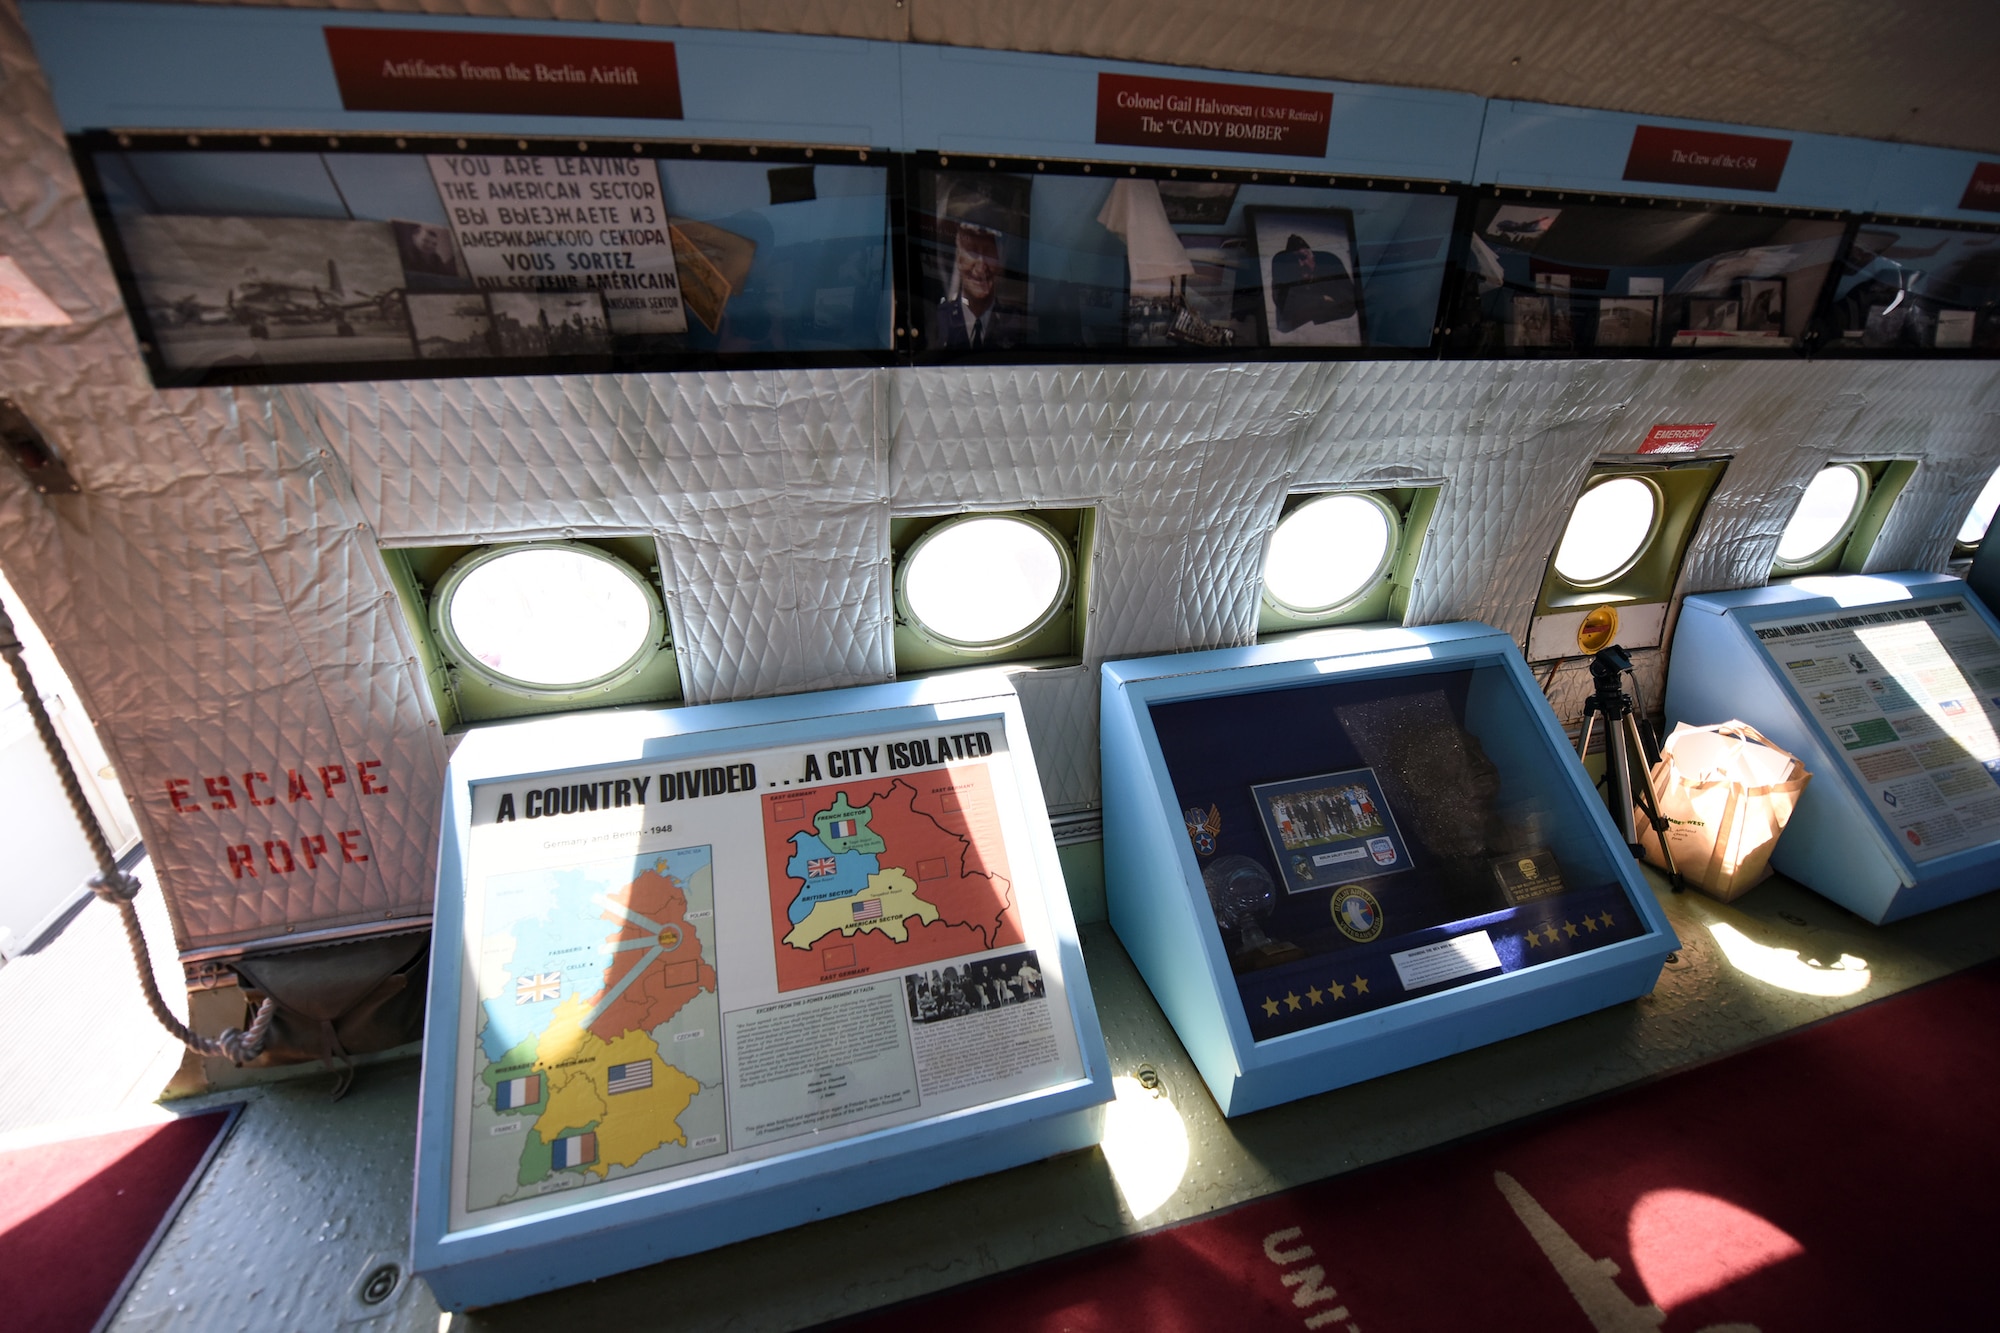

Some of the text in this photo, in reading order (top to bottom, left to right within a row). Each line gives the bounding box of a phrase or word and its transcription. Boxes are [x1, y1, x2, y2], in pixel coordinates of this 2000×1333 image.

[382, 59, 639, 85] Artifacts from the Berlin Airlift
[1117, 91, 1164, 111] Colonel
[1167, 95, 1192, 113] Gail
[1195, 97, 1253, 117] Halvorsen
[1141, 116, 1164, 133] The
[444, 157, 641, 177] YOU ARE LEAVING
[1671, 149, 1758, 170] The Crew of the C-54
[442, 182, 655, 200] THE AMERICAN SECTOR
[454, 206, 655, 225] ВЫ ВЫЕЗЖАЕТЕ ИЗ
[462, 229, 666, 248] АМЕРИКАНСКОГО СЕКТОРА
[501, 252, 635, 271] VOUS SORTEZ
[585, 271, 676, 291] AMÉRICAIN
[1654, 429, 1709, 439] EMERGENCY
[1755, 627, 1785, 640] SPECIAL
[1781, 624, 1810, 636] THANKS
[1807, 622, 1820, 632] TO
[1816, 620, 1832, 631] THE
[1828, 616, 1864, 630] FOLLOWING
[165, 760, 389, 813] ESCAPE
[495, 793, 517, 825] A
[526, 775, 649, 820] COUNTRY
[660, 763, 757, 803] DIVIDED
[829, 745, 880, 779] CITY
[886, 731, 994, 770] ISOLATED
[947, 783, 974, 792] GERMANY
[787, 791, 817, 799] GERMANY
[817, 810, 866, 821] FRENCH SECTOR
[543, 824, 673, 849] Germany and Berlin 1948
[227, 830, 369, 879] ROPE
[802, 889, 853, 902] BRITISH SECTOR
[1334, 888, 1375, 912] BERLIN AIRLIFT
[690, 911, 710, 919] POLAND
[845, 914, 903, 929] AMERICAN SECTOR
[566, 963, 586, 971] CELLE
[820, 967, 870, 982] EAST GERMANY
[756, 1006, 777, 1014] EXCERPT
[824, 990, 852, 1000] AGREEMENT
[1263, 1226, 1361, 1333] UNI
